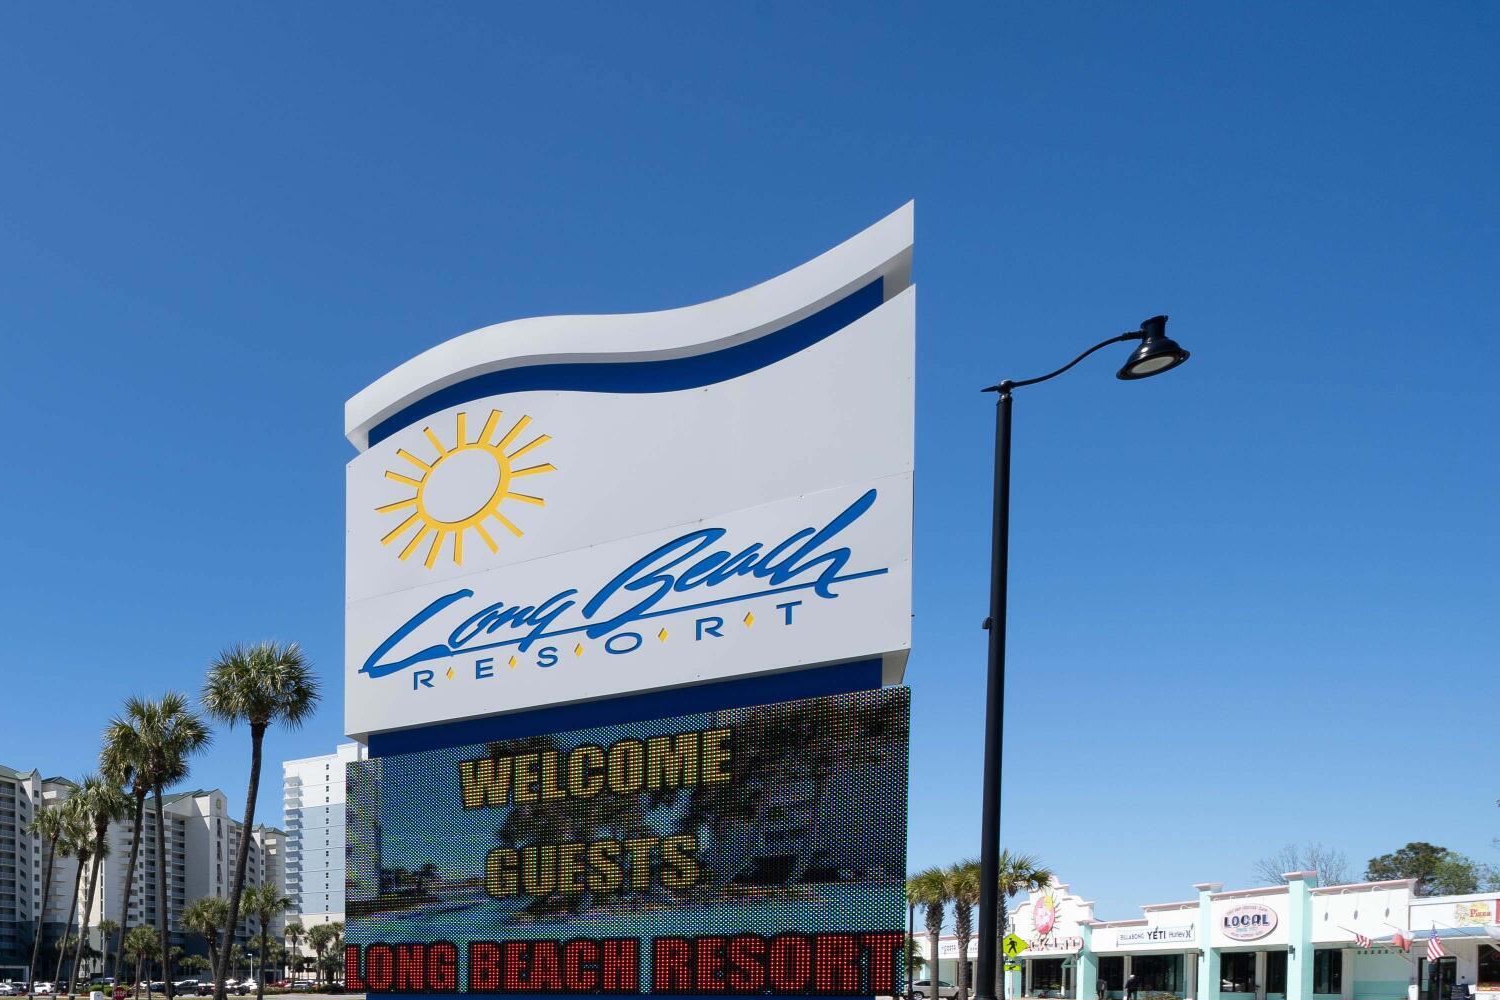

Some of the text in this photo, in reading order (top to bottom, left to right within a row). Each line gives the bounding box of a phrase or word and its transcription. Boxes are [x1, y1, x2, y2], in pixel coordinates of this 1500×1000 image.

[358, 488, 889, 679] Long Beach
[412, 600, 803, 691] RESORT
[458, 727, 734, 808] WELCOME
[485, 834, 702, 899] GUESTS
[1147, 930, 1166, 940] YETI
[1223, 914, 1269, 928] LOCAL
[345, 932, 904, 993] LONG BEACH RESORT
